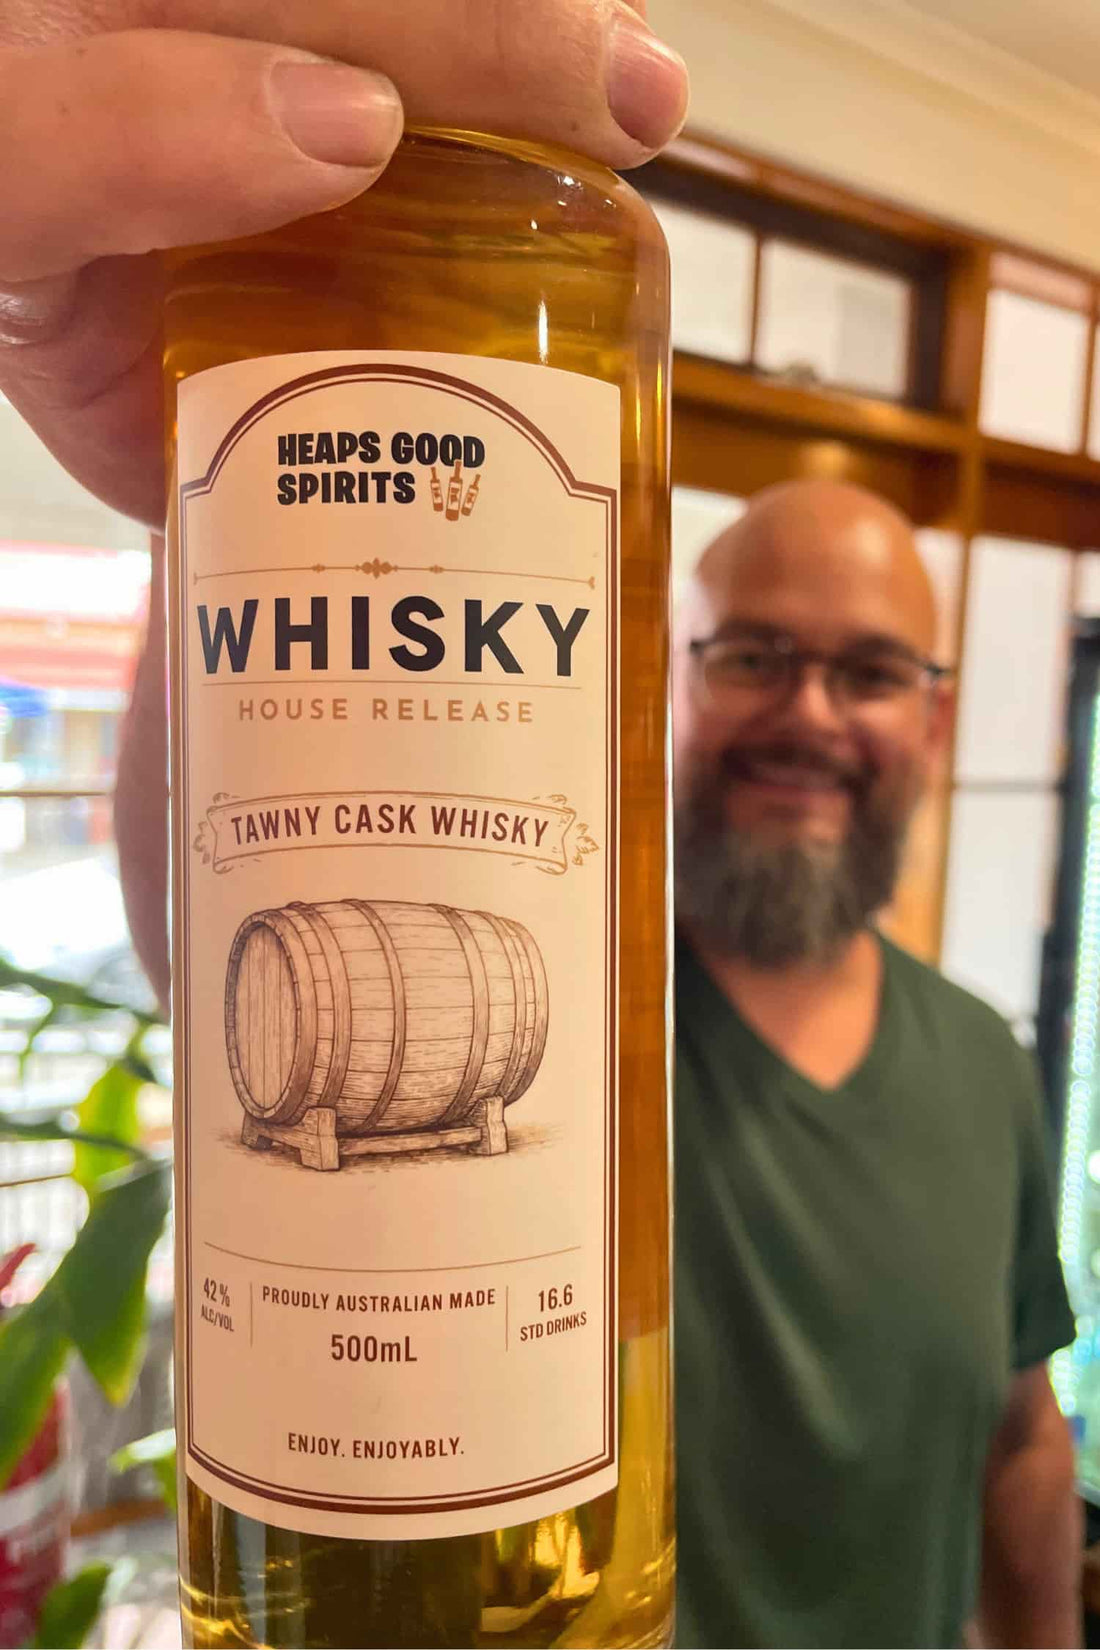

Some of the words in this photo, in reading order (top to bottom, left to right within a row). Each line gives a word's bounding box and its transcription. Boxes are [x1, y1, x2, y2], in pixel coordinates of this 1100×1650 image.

[277, 431, 380, 466] HEAPS
[390, 432, 486, 468] GOOD
[277, 471, 416, 505] SPIRITS
[197, 595, 590, 677] WHISKY
[238, 698, 348, 721] HOUSE
[372, 699, 533, 723] RELEASE
[231, 806, 320, 846] TAWNY
[334, 804, 417, 835] CASK
[430, 805, 549, 848] WHISKY
[262, 1286, 329, 1311] PROUDLY
[336, 1295, 443, 1312] AUSTRALIAN
[449, 1288, 496, 1309] MADE
[538, 1284, 573, 1313] 16.6
[200, 1304, 234, 1333] ALC/VOL
[520, 1324, 543, 1342] STD
[546, 1311, 587, 1335] DRINKS
[331, 1334, 417, 1363] 500mL
[288, 1433, 345, 1457] ENJOY.
[353, 1437, 465, 1459] ENJOYABLY.
